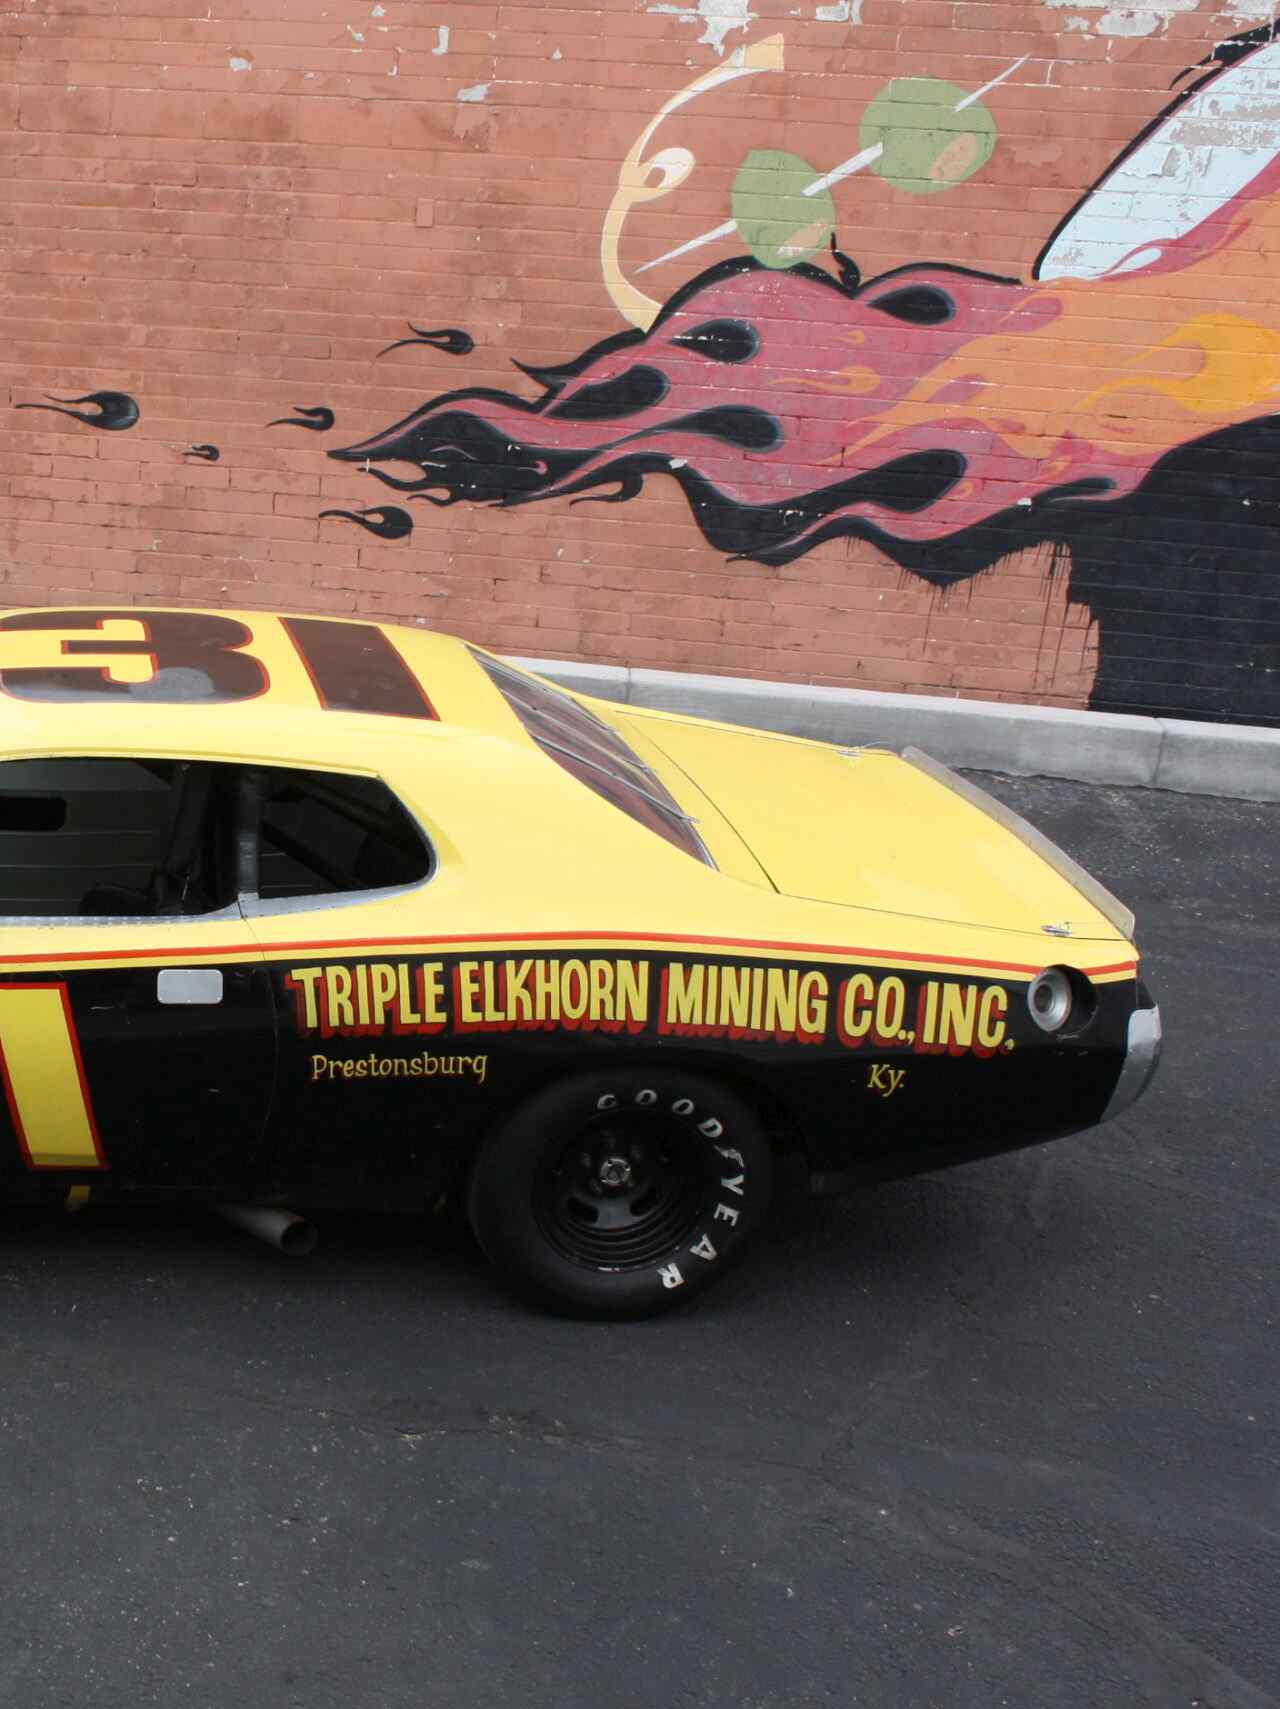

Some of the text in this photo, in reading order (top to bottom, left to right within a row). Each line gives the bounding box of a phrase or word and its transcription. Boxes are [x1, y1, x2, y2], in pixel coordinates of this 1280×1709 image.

[287, 962, 449, 1037] TRIPLE
[453, 958, 651, 1034] ELKHORN
[659, 961, 830, 1046] MINING
[919, 980, 1017, 1057] INC.
[312, 1052, 488, 1083] Prestonsburg
[867, 1063, 906, 1097] Ky.
[596, 1088, 745, 1289] GOODYEAR
